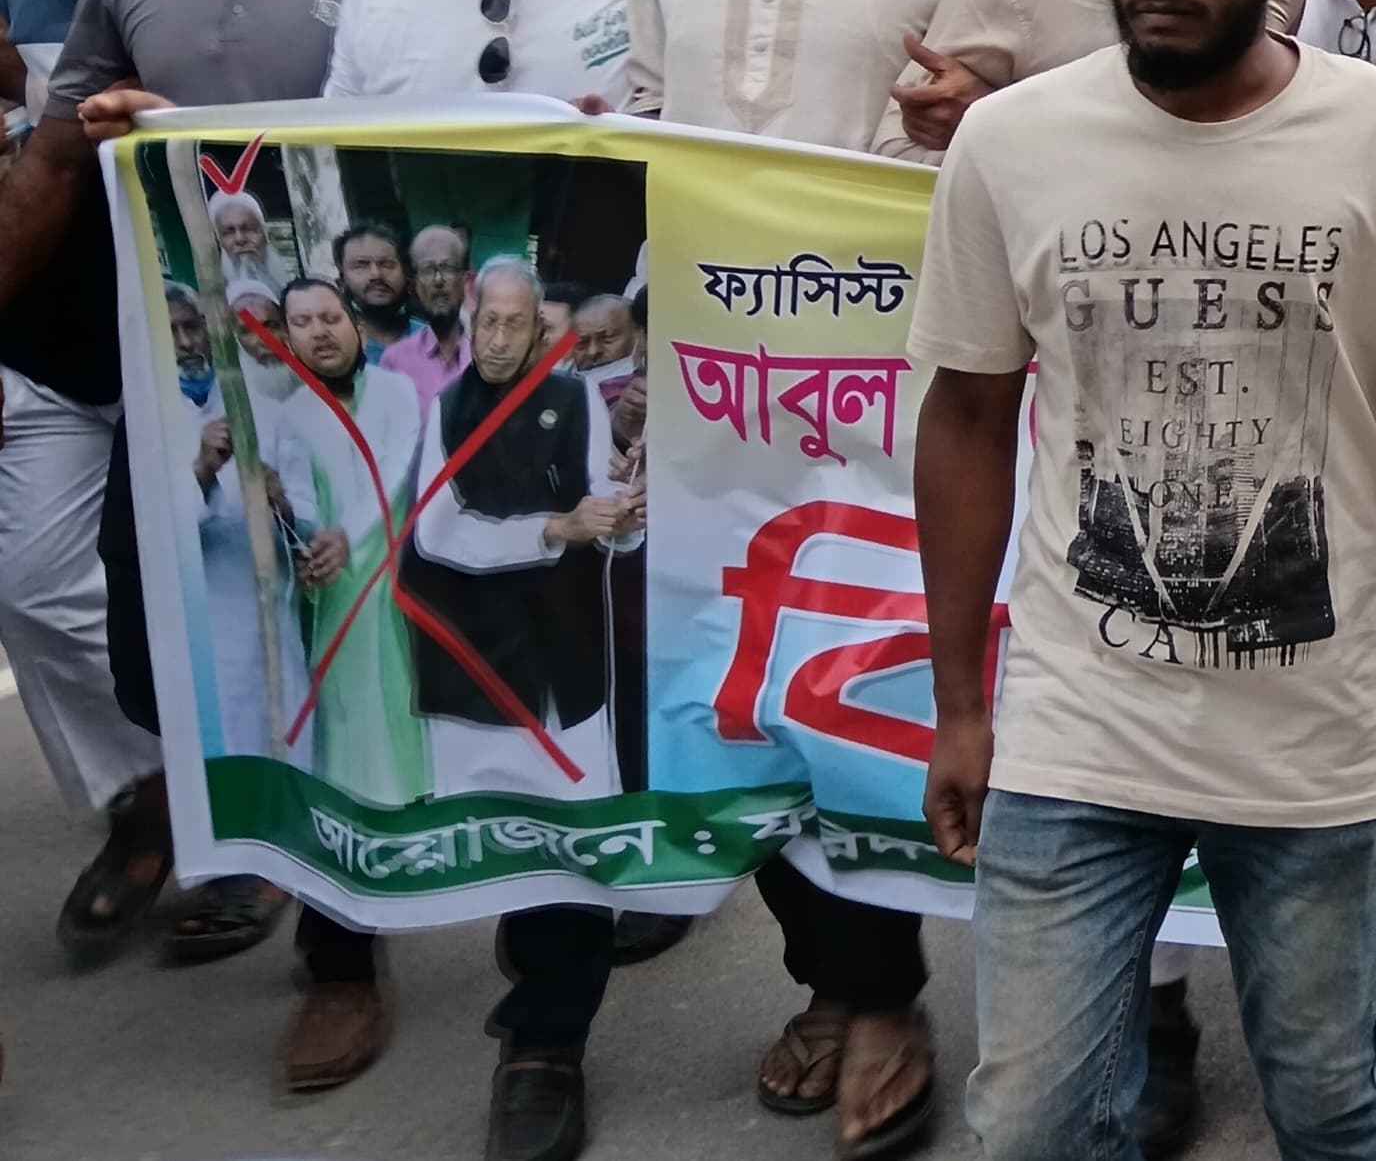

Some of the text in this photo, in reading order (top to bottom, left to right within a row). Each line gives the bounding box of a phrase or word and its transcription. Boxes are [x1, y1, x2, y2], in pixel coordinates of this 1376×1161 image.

[1057, 218, 1342, 271] LOS ANGELES
[697, 254, 913, 317] ফ্যাসিস্ট
[1061, 277, 1338, 333] GUESS
[671, 340, 913, 467] আবুল
[1146, 359, 1250, 396] EST.
[1119, 416, 1273, 450] EIGHTY
[1146, 480, 1234, 510] ONE
